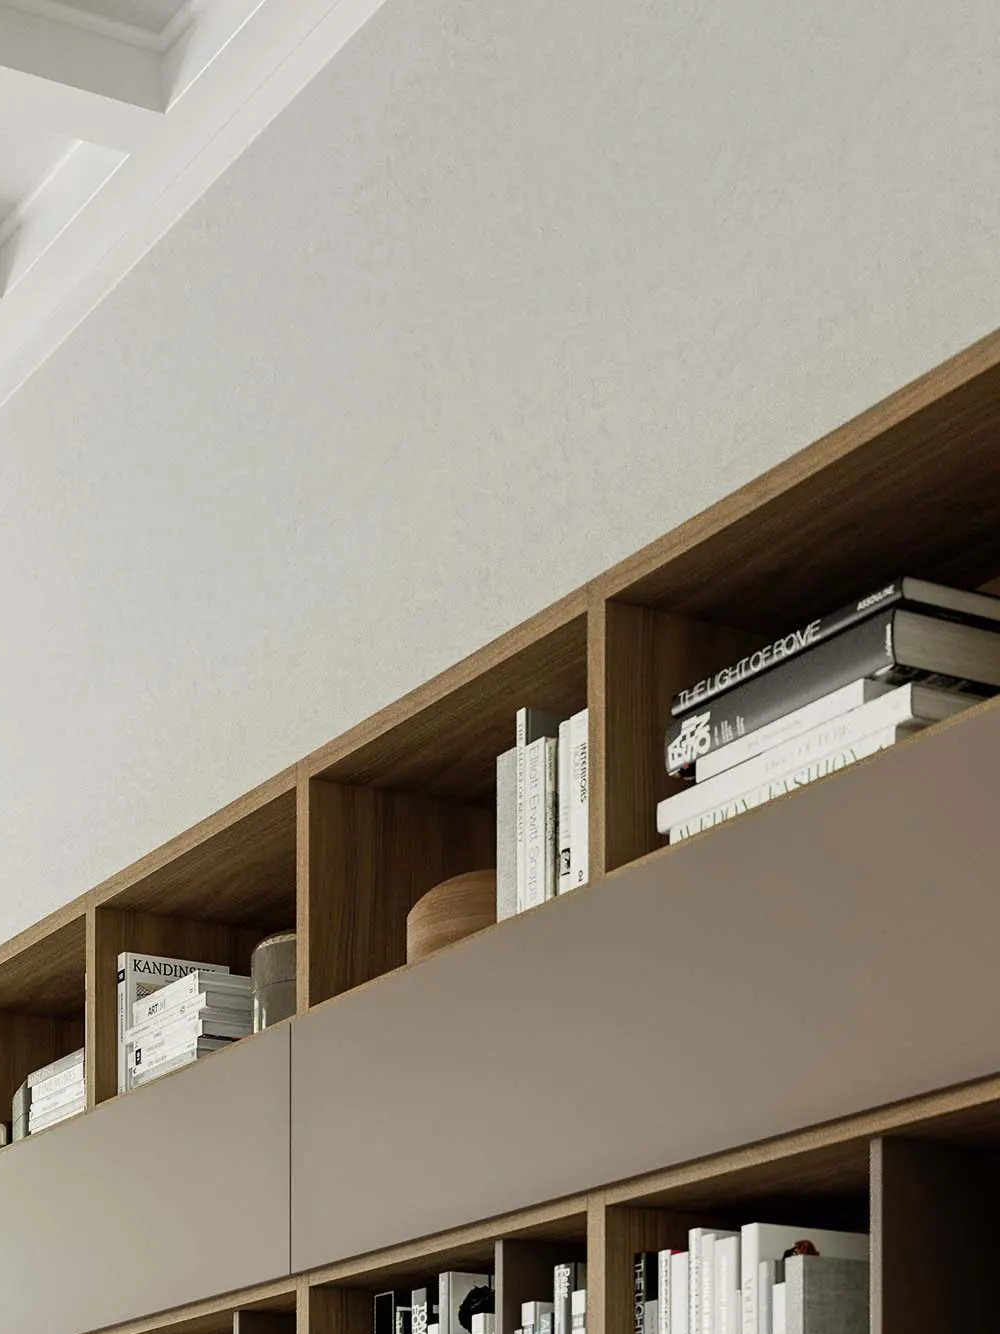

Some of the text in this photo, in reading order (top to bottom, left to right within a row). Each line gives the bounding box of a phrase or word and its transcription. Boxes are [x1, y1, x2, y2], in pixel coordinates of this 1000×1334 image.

[678, 619, 822, 708] THE LIGHT OF ROME
[133, 959, 216, 978] KANDINS
